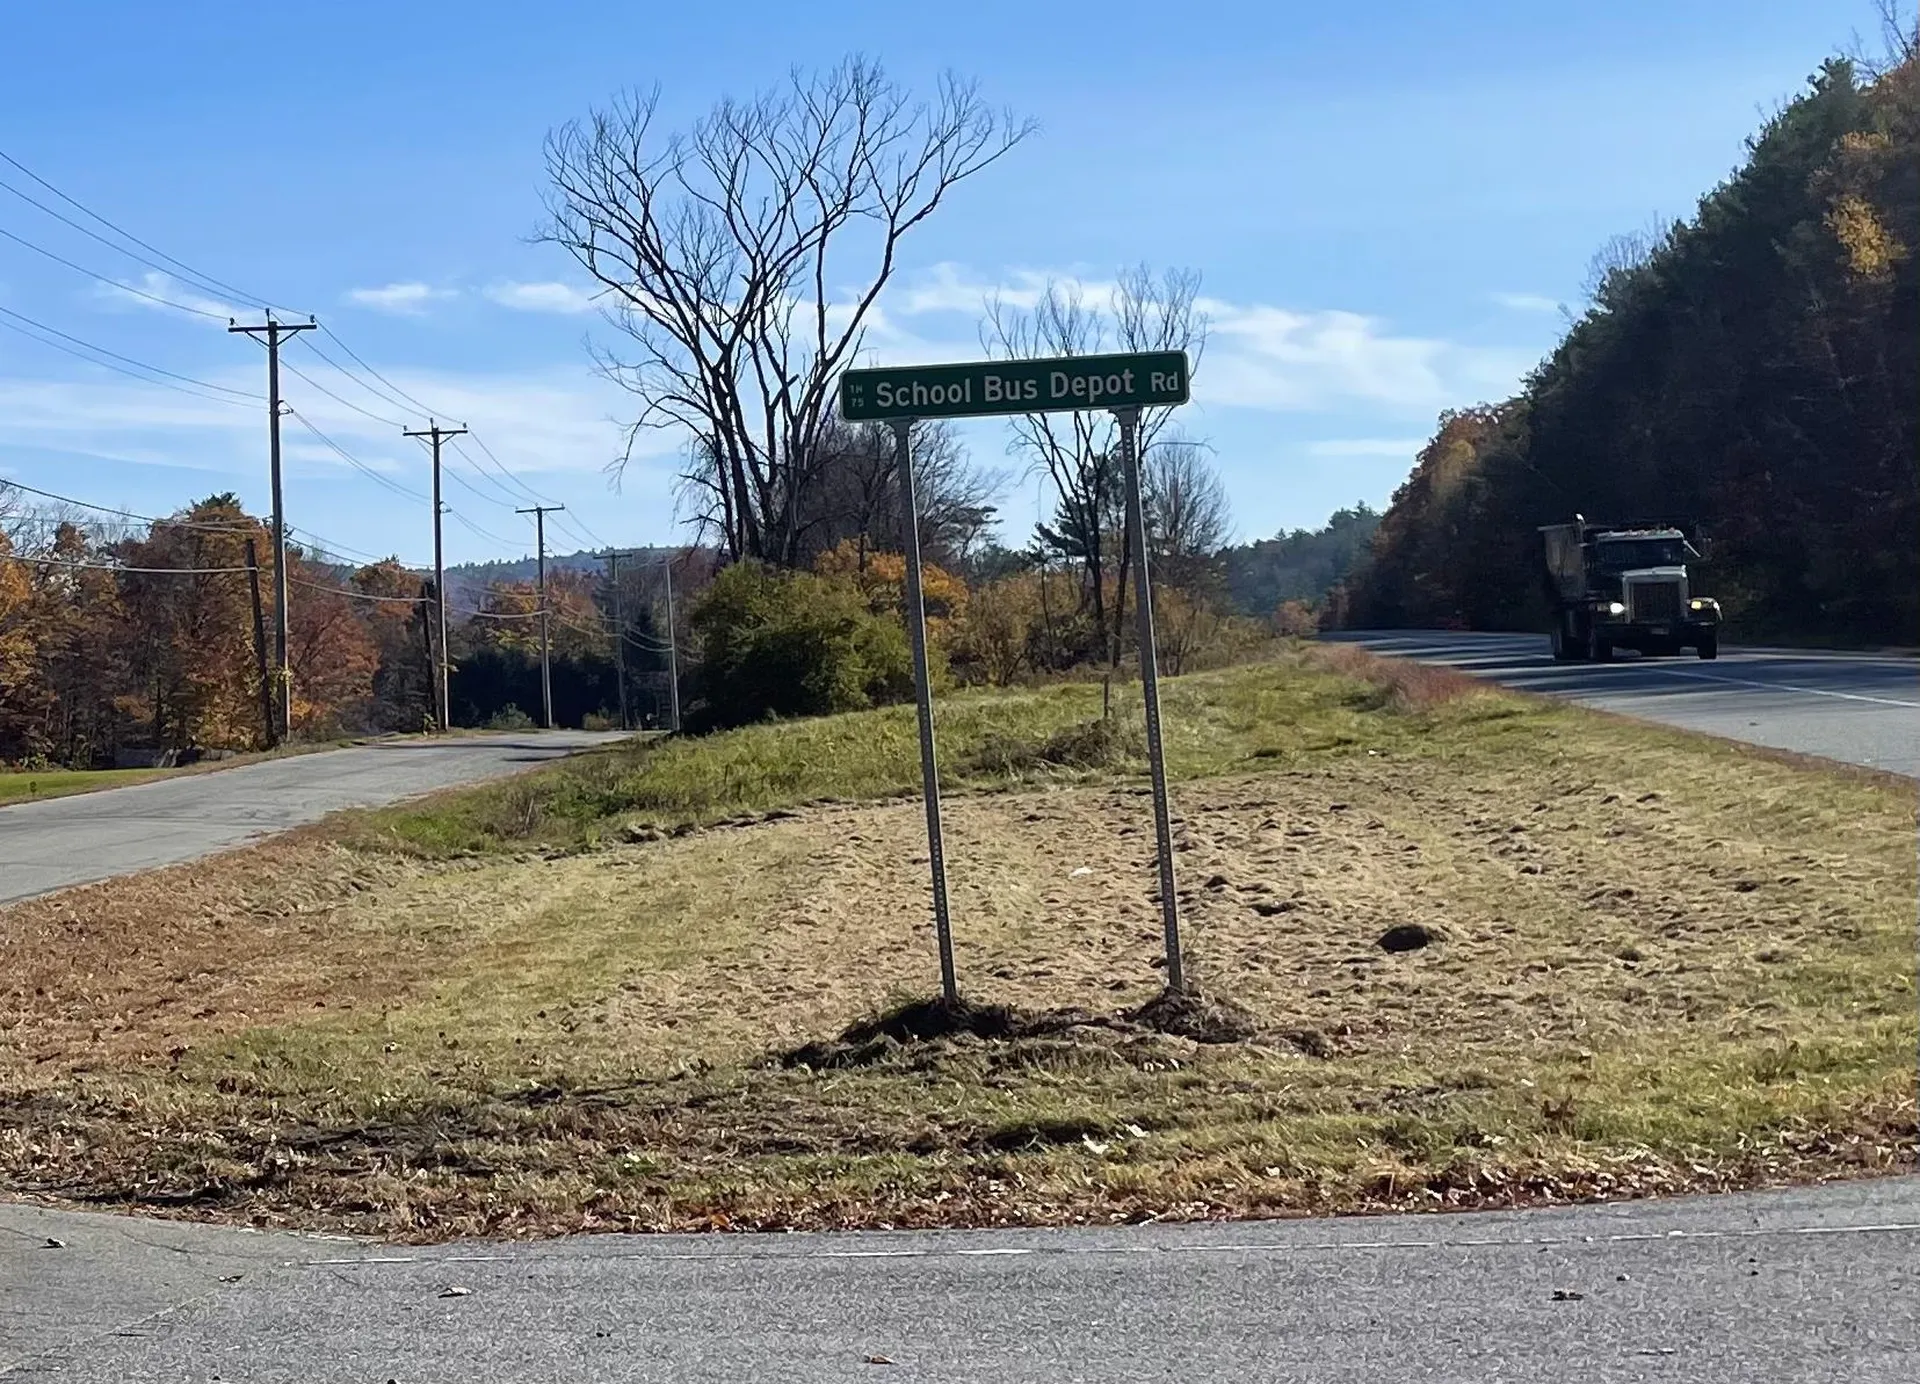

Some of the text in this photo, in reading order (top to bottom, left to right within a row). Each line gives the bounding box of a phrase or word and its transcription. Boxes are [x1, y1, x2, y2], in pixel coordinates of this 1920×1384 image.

[876, 368, 1178, 407] School Bus Depot Rd
